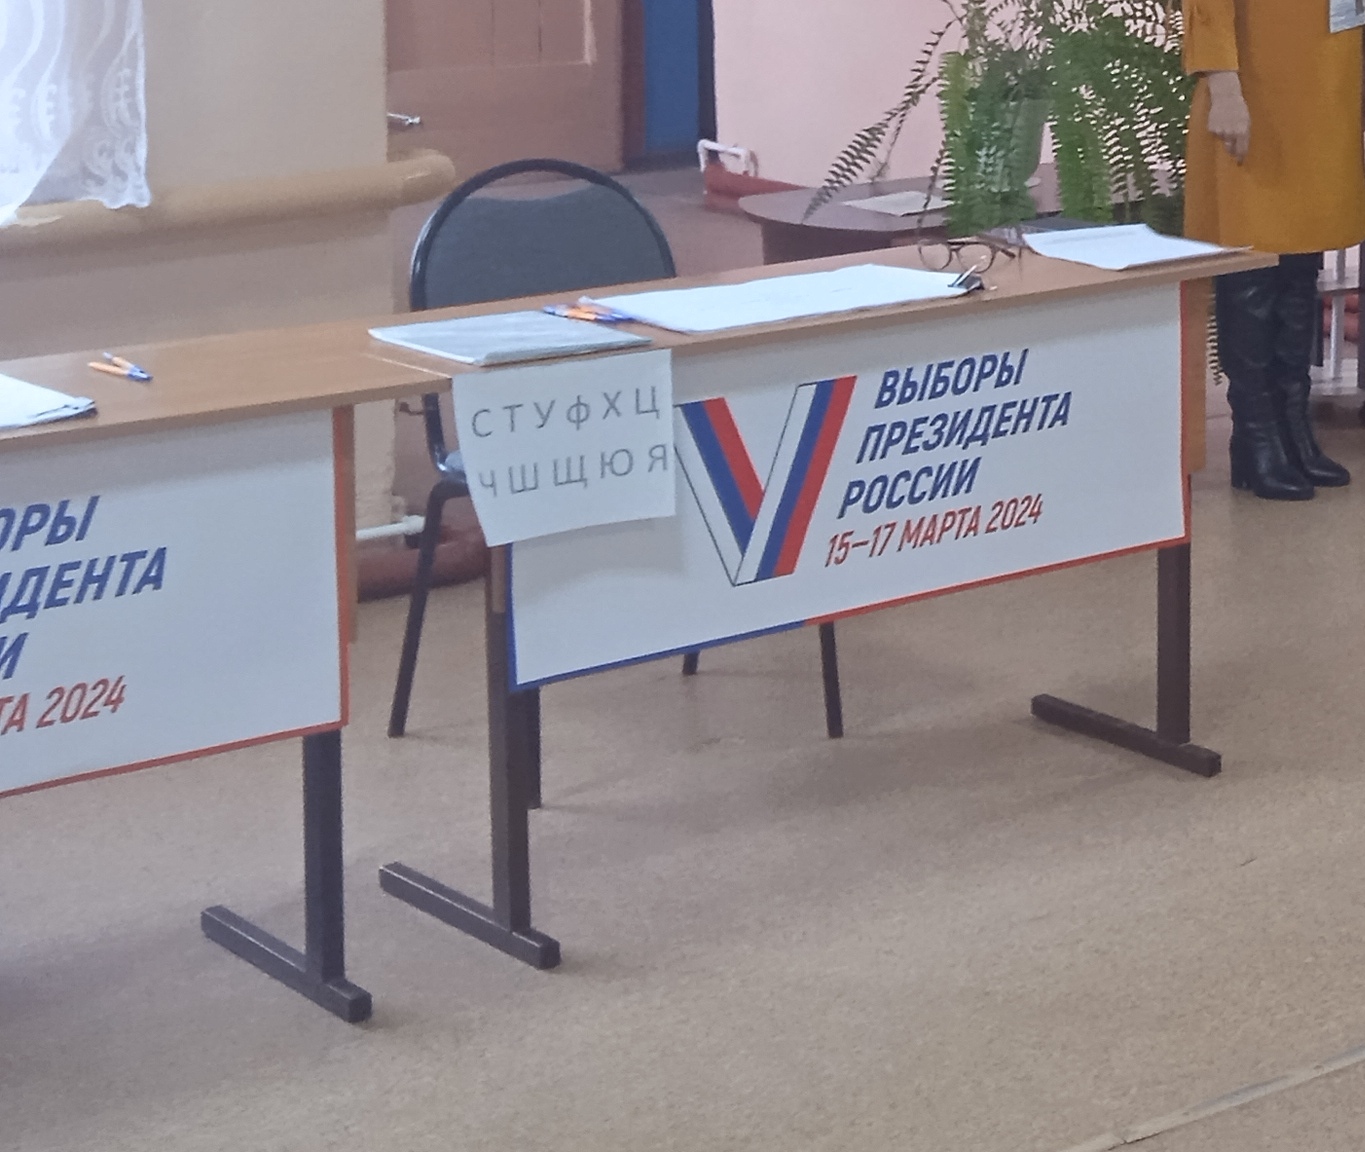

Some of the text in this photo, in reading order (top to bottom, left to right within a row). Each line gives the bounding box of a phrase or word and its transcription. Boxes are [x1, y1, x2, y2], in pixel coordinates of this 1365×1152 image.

[873, 348, 1030, 410] ВЫБОРЫ
[855, 391, 1074, 465] ПРЕЗИДЕНТА
[836, 456, 982, 520] РОССИИ
[896, 504, 983, 553] МАРТА
[984, 493, 1044, 535] 2024
[35, 674, 128, 729] 2024
